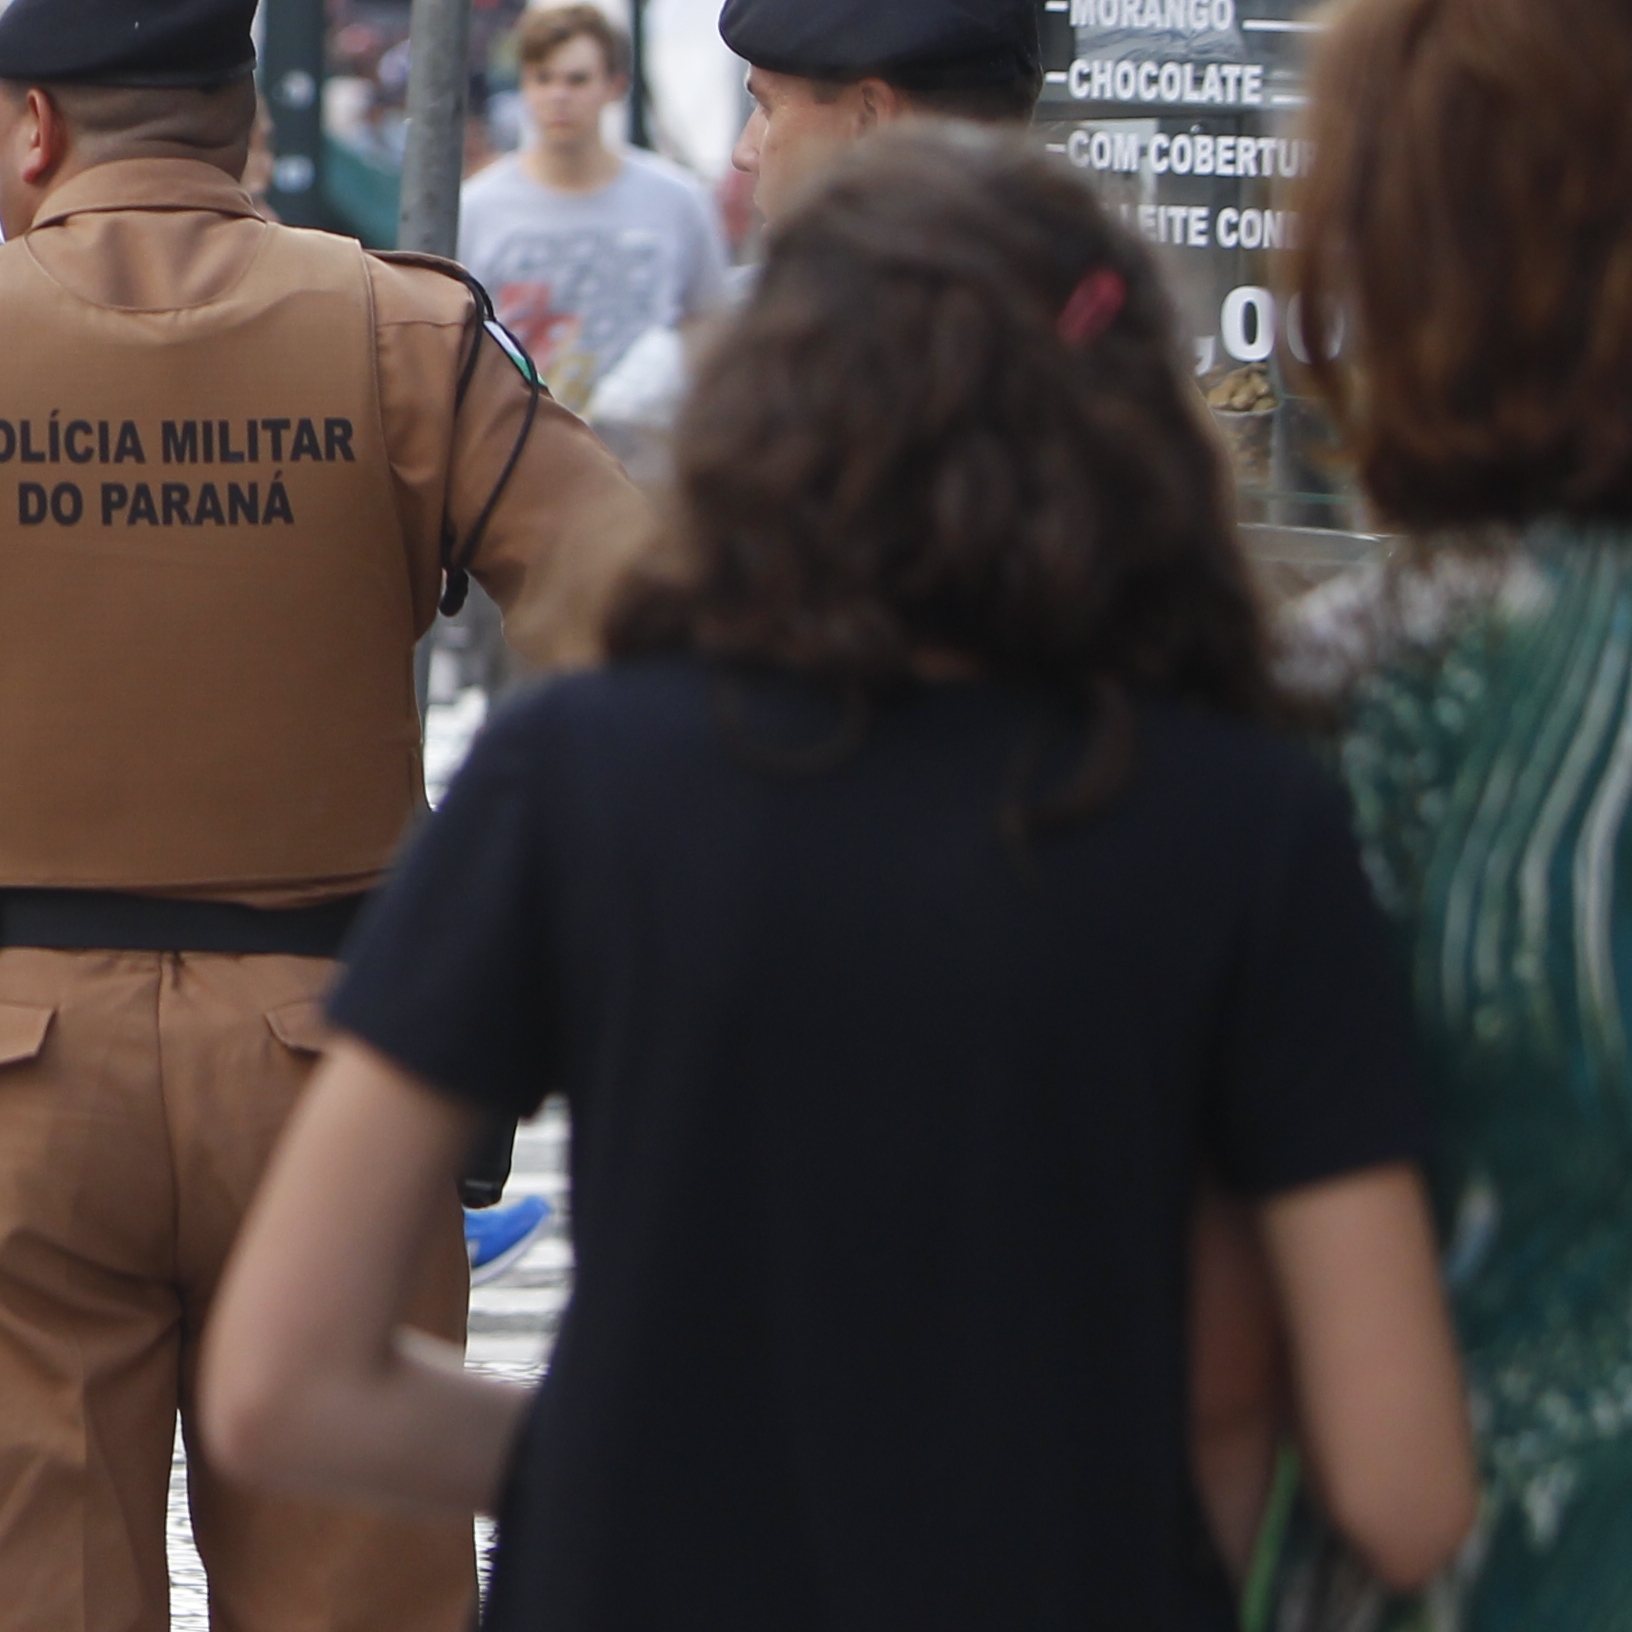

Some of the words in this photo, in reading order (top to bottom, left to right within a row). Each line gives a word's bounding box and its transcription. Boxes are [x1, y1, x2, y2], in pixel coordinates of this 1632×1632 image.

[1068, 58, 1263, 104] CHOCOLATE
[1067, 129, 1140, 172] COM
[161, 417, 356, 464] MILITAR
[18, 481, 83, 526] DO
[100, 469, 295, 527] PARANÁ
